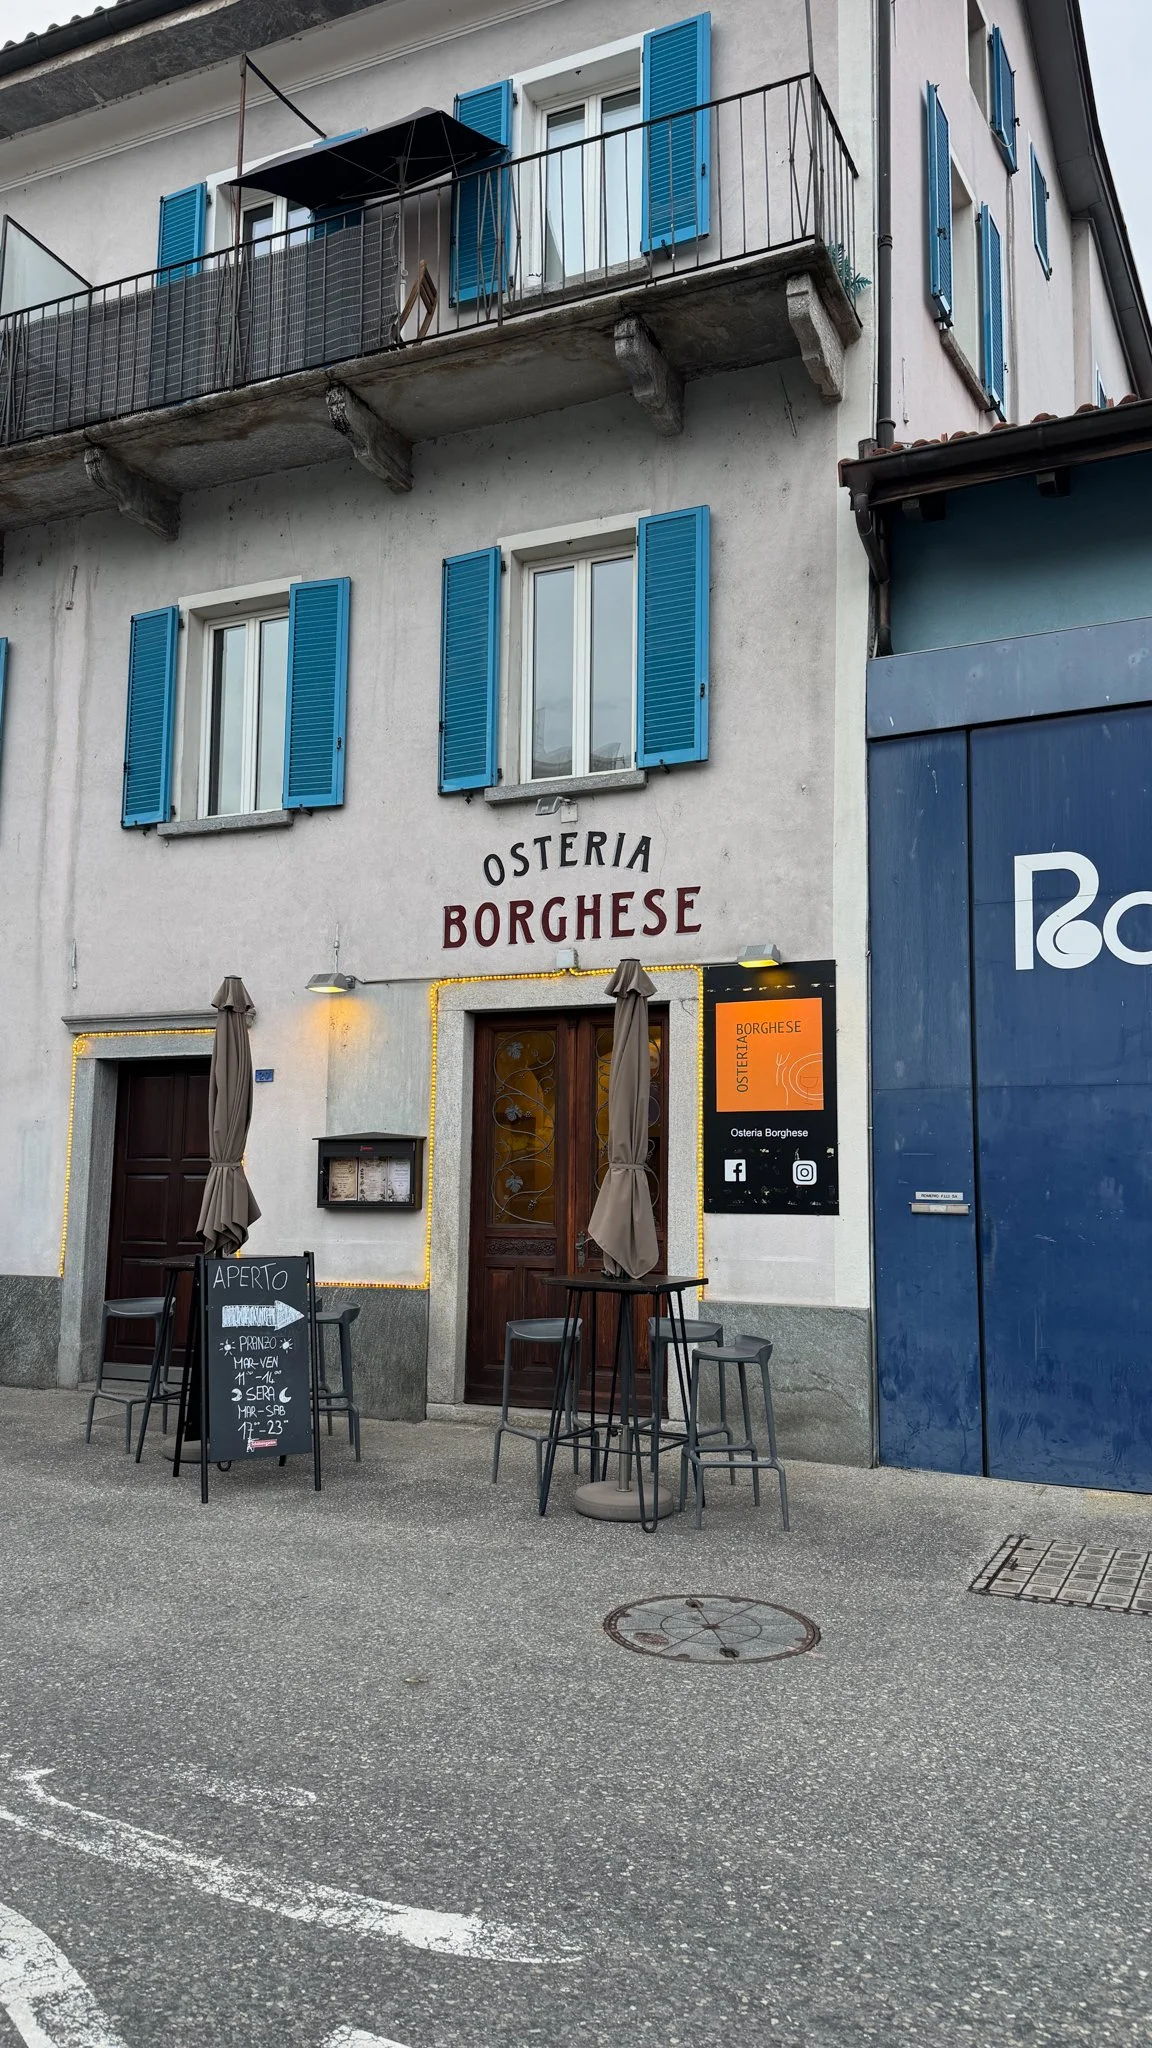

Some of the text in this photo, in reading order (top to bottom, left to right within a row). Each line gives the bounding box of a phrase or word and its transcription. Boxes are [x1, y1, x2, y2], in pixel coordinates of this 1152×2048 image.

[483, 831, 652, 886] OSTERIA
[442, 886, 702, 950] BORGHESE
[736, 1020, 802, 1035] BORGHESE
[736, 1035, 749, 1093] OSTERIA
[730, 1128, 809, 1139] Osteria Borghese
[213, 1263, 288, 1291] APERTO
[239, 1335, 277, 1352] PRANZO
[246, 1385, 275, 1401] SERA
